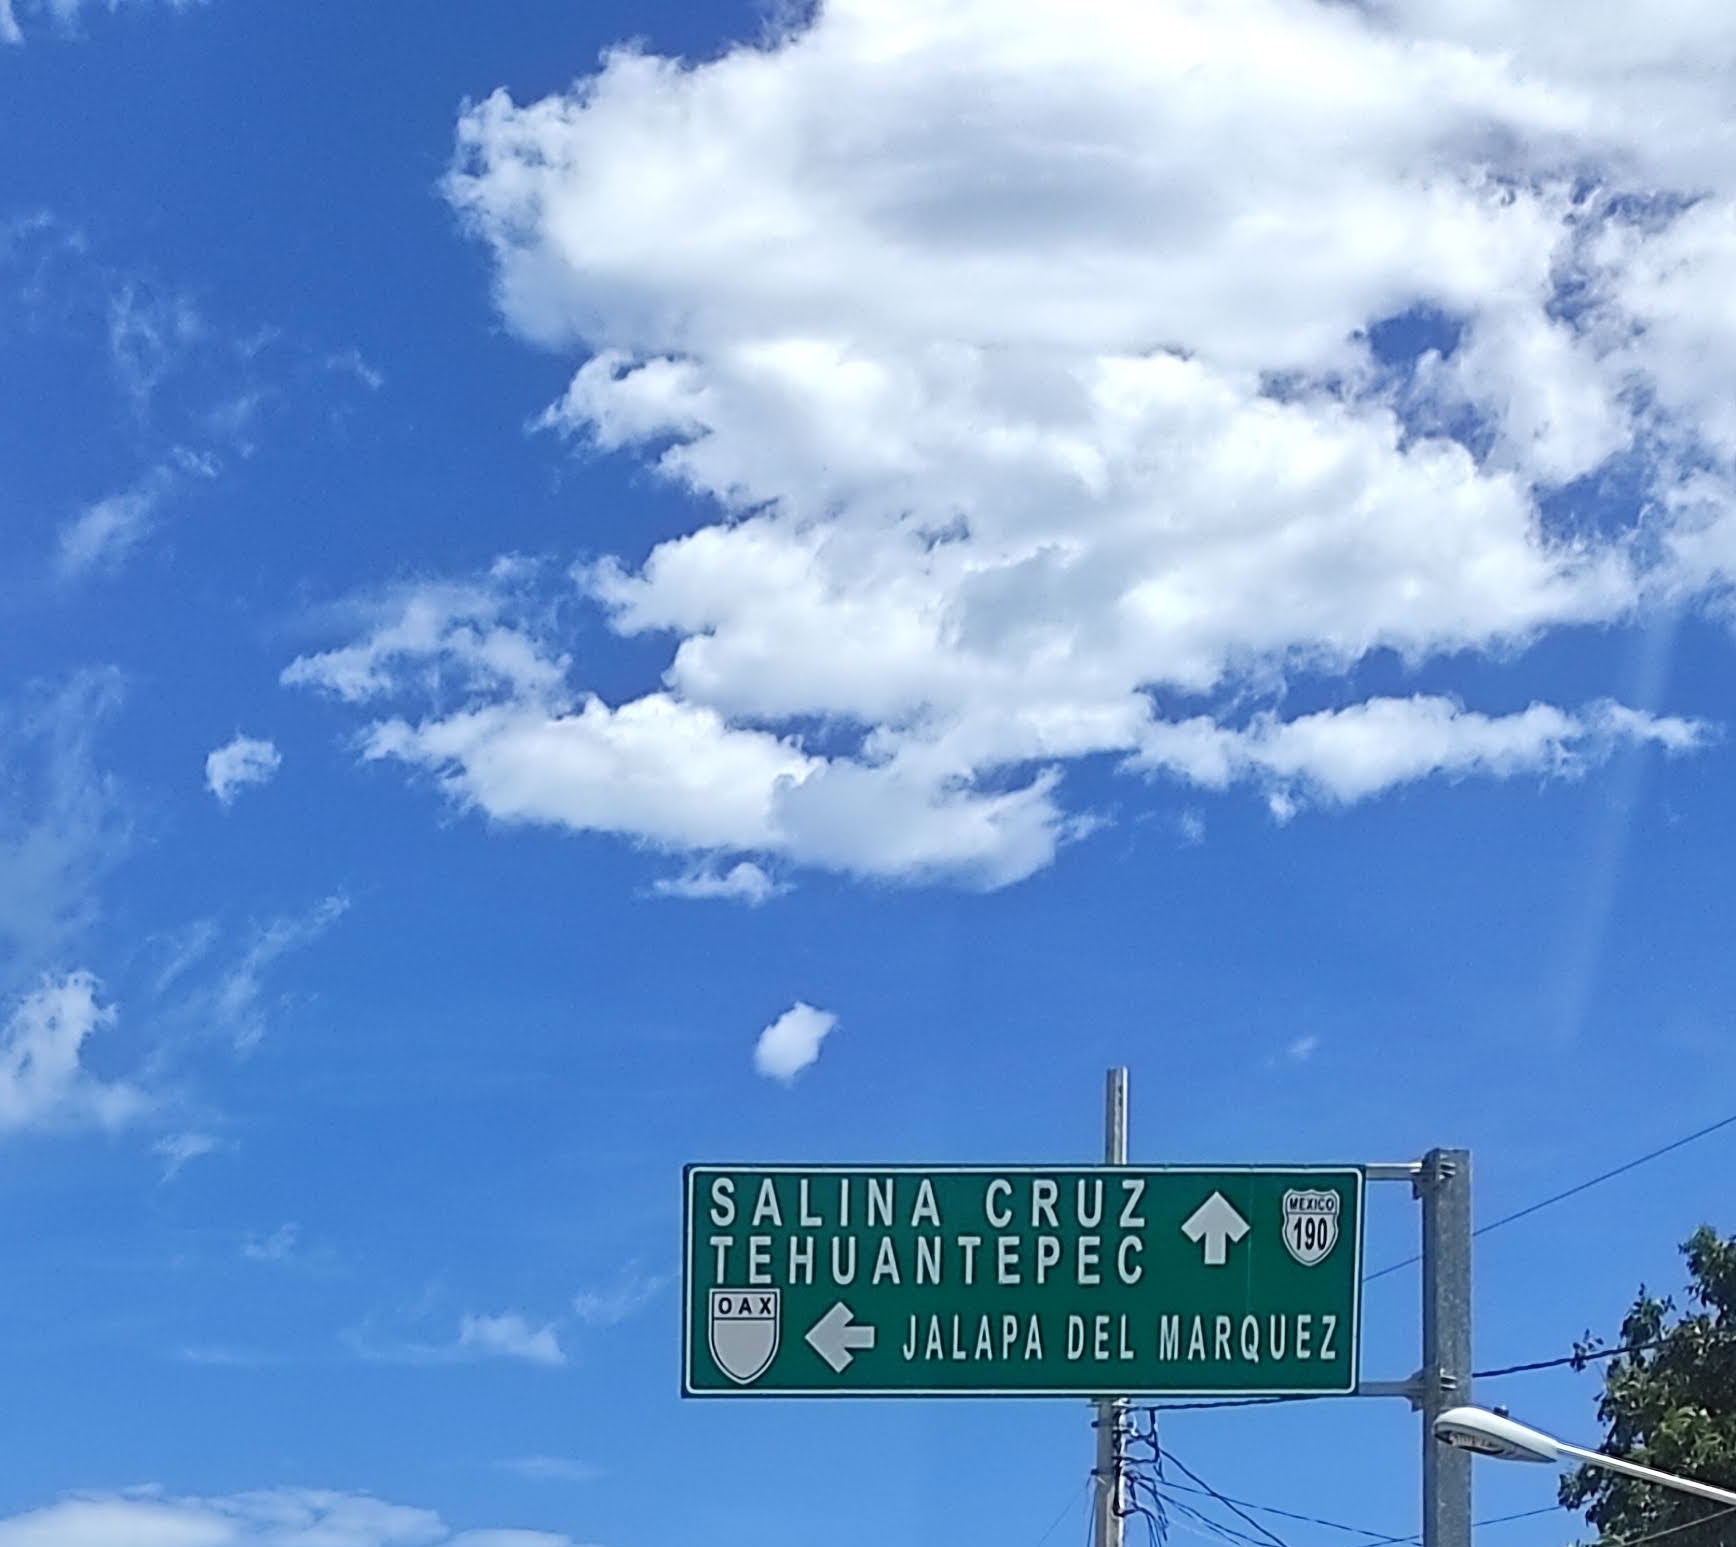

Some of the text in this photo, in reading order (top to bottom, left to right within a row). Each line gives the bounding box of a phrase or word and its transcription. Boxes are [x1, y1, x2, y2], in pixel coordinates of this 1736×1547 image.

[709, 1178, 1148, 1228] SALINA CRUZ
[1289, 1197, 1335, 1211] MEXICO
[1293, 1216, 1328, 1251] 190
[709, 1235, 1144, 1286] TEHUANTEPEC
[717, 1297, 772, 1315] OAX
[902, 1314, 1338, 1363] JALAPA DEL MARQUEZ
